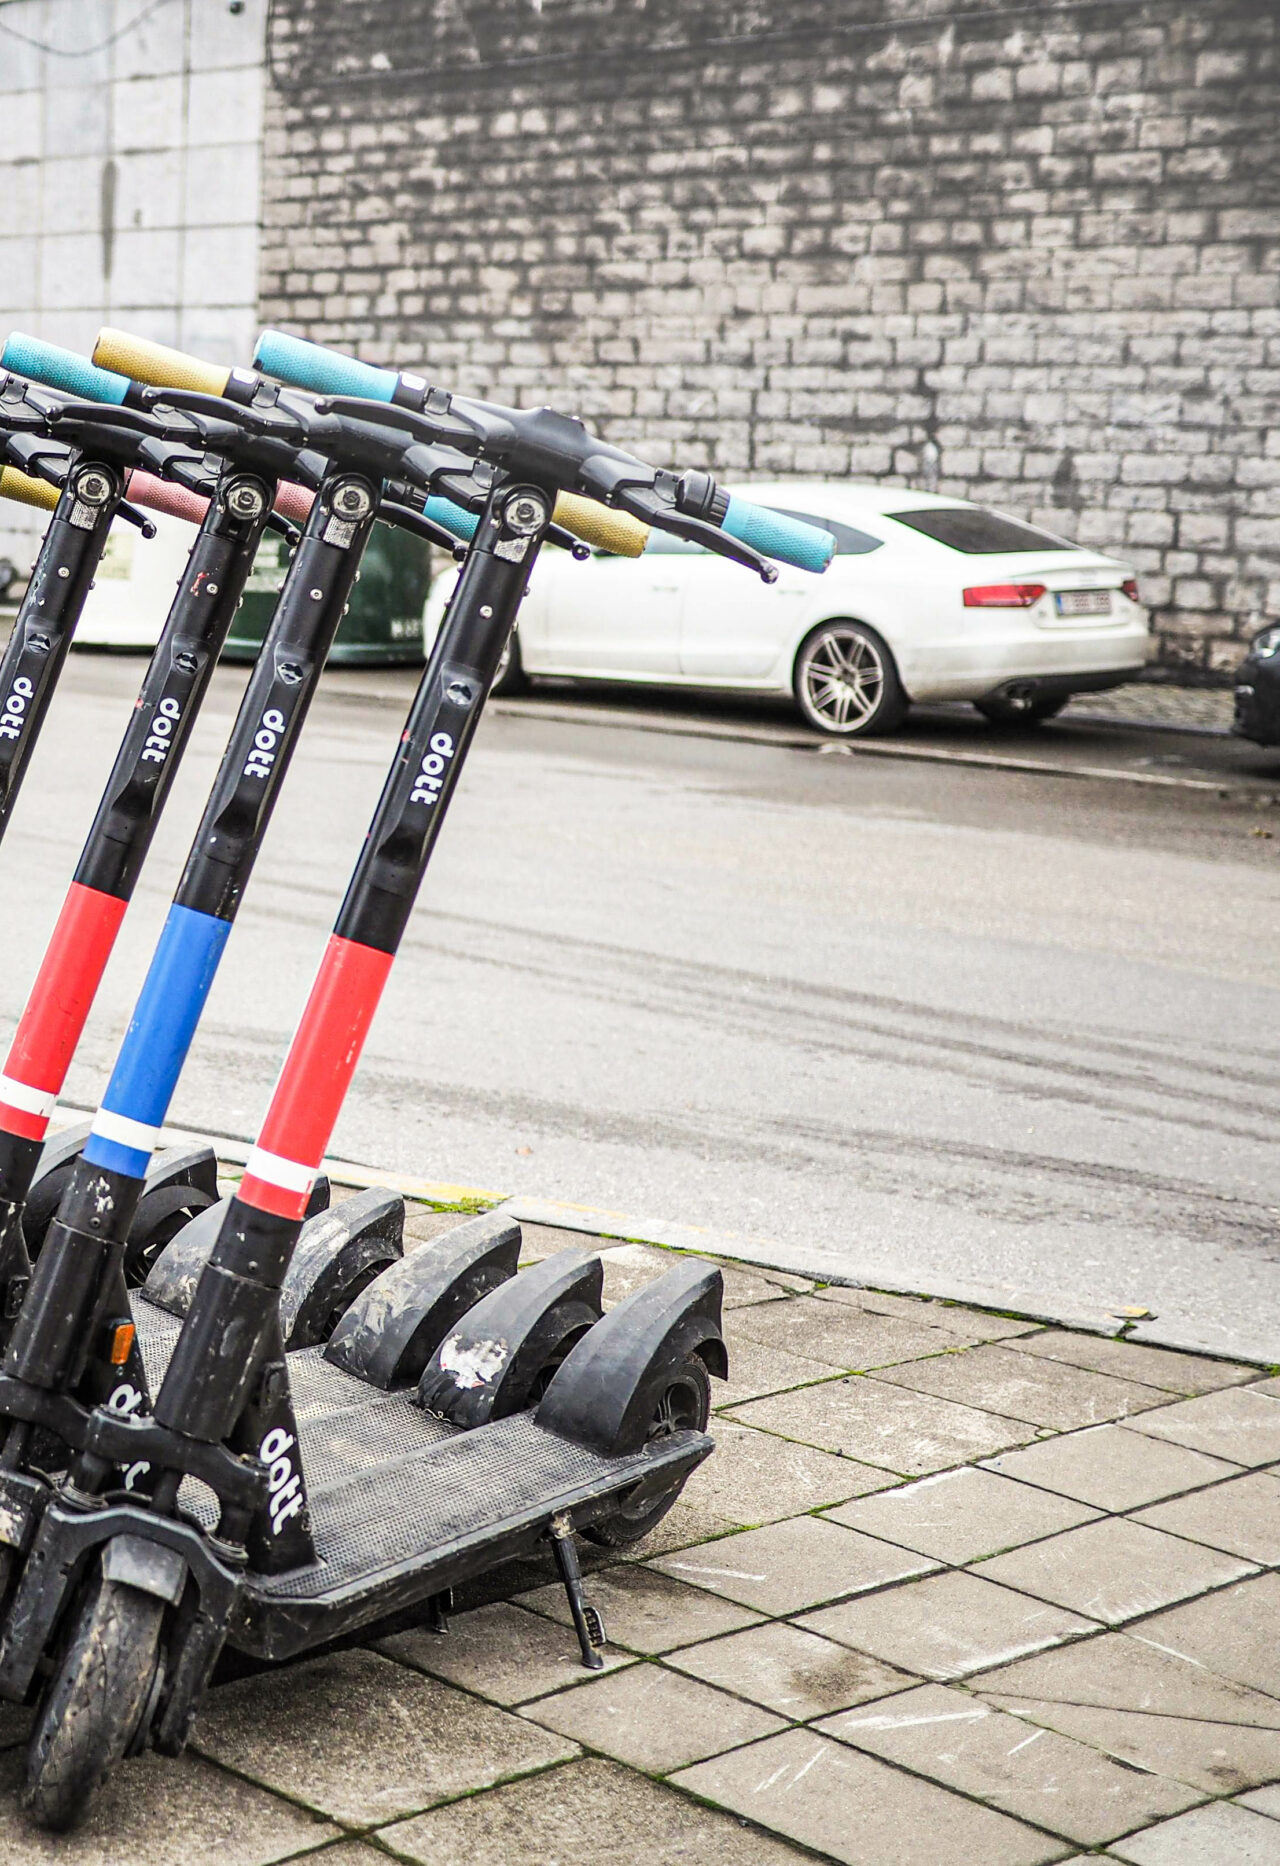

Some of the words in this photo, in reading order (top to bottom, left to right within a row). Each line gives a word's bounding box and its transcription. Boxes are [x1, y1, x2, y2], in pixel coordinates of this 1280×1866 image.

[141, 697, 181, 763] dott
[243, 709, 286, 779] dott
[409, 732, 455, 805] dott
[260, 1428, 304, 1536] dott
